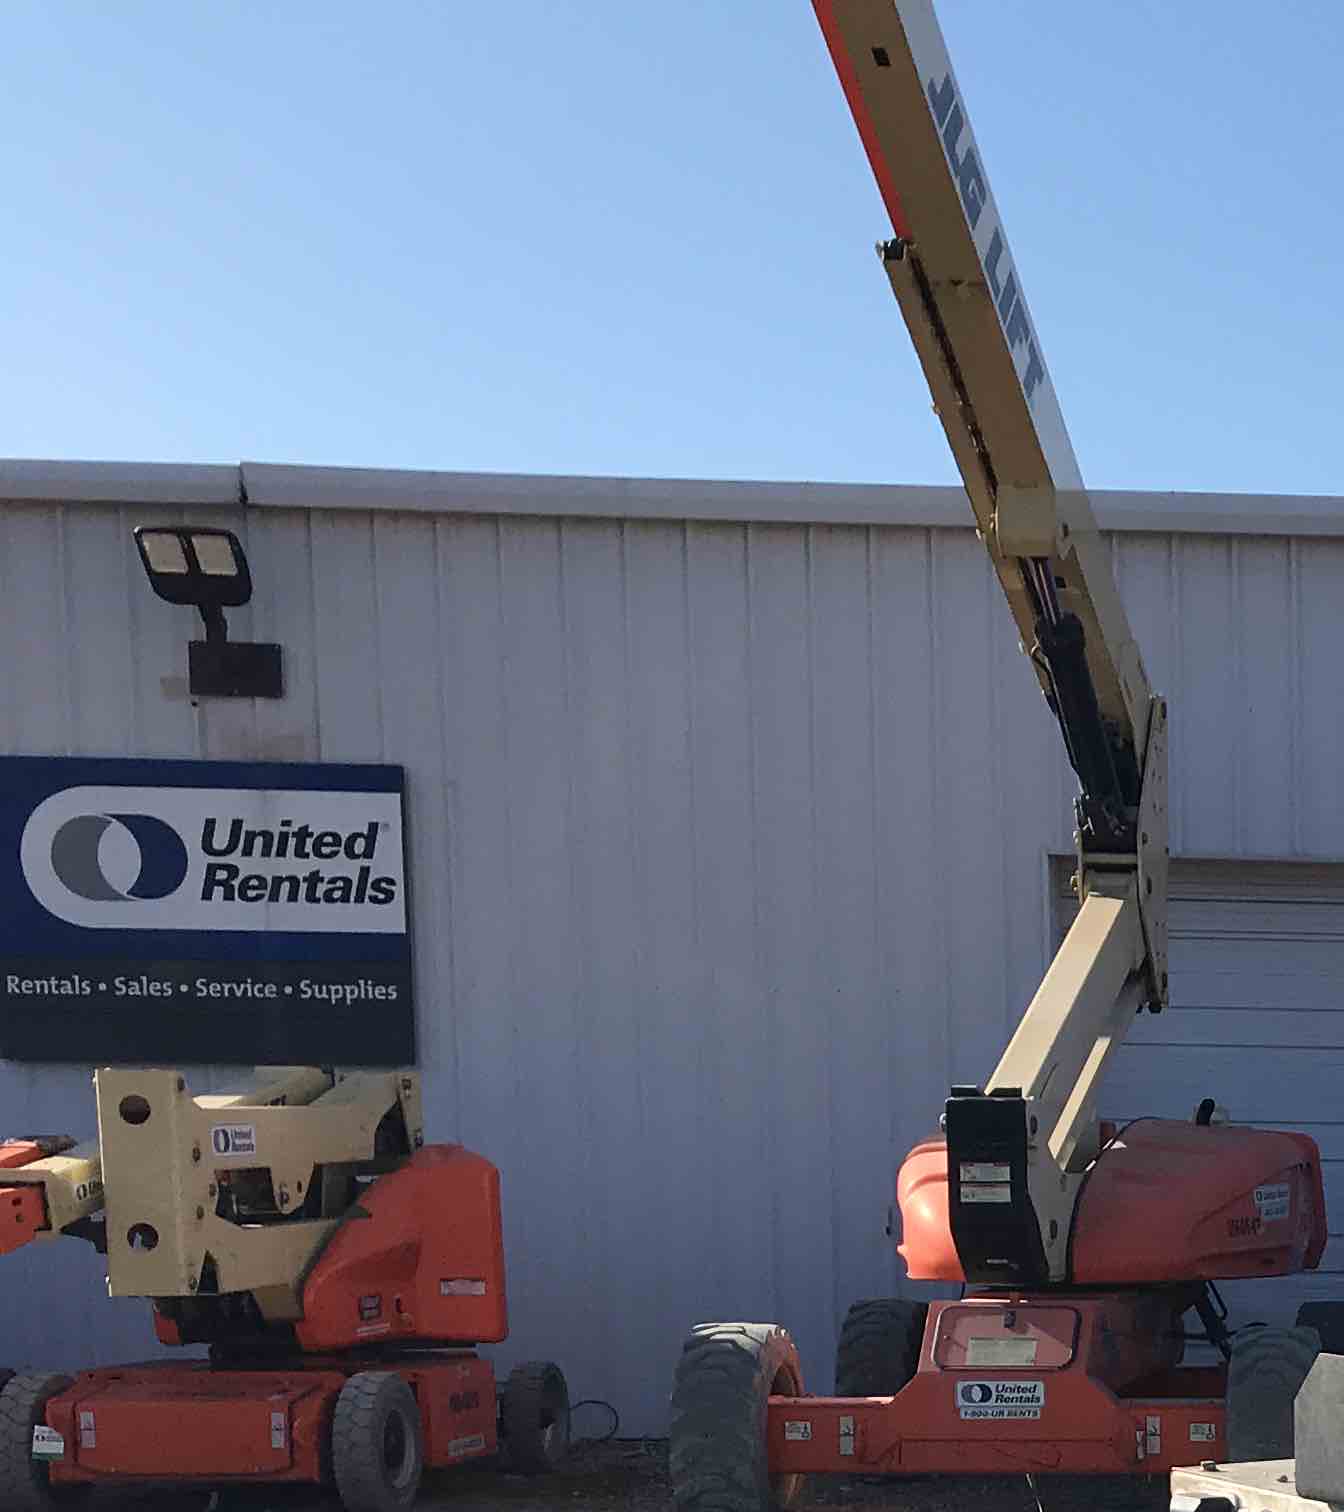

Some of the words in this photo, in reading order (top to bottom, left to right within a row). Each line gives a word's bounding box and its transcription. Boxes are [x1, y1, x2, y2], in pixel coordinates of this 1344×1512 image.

[927, 72, 986, 231] JLG
[982, 226, 1045, 400] LIFT
[201, 817, 380, 860] United
[200, 862, 397, 905] Rentals
[6, 974, 92, 995] Rentals
[114, 975, 173, 997] Sales
[195, 977, 278, 998] Service
[299, 979, 398, 1005] Supplies
[994, 1384, 1037, 1394] United
[994, 1395, 1040, 1404] Rentals
